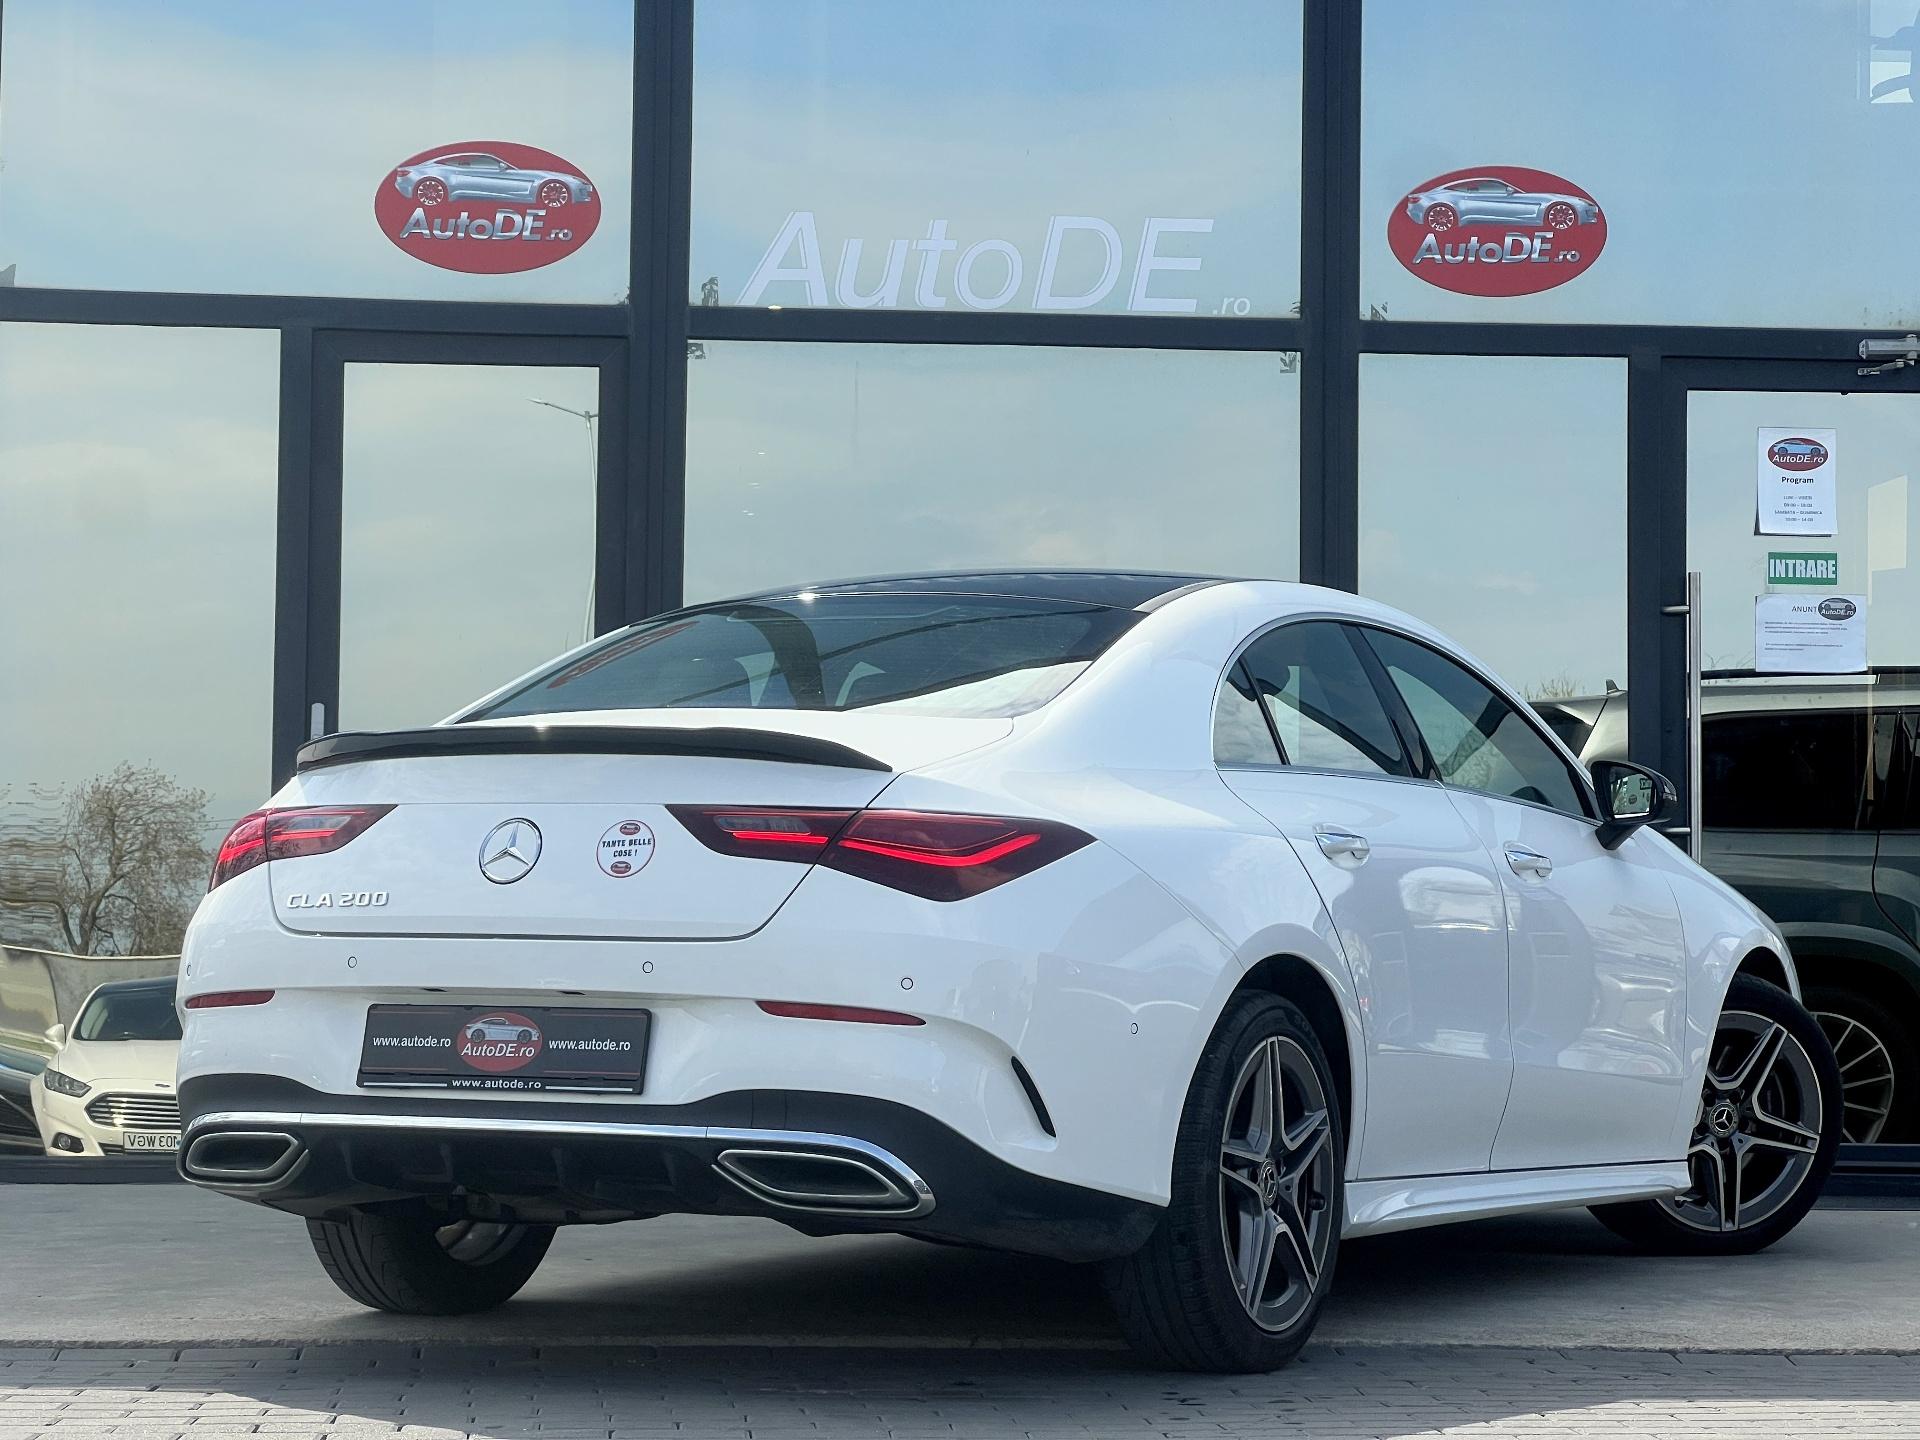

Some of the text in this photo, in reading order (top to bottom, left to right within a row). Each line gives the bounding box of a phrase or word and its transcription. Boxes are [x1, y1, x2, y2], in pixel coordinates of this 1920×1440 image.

[1772, 454, 1824, 464] AutoDE.ro
[1781, 476, 1814, 484] Program
[1769, 559, 1836, 578] INTRARE
[602, 838, 652, 848] TANTE BELLE
[613, 849, 632, 857] COSE
[286, 891, 389, 908] CLA 200
[372, 1035, 451, 1048] www.autode.ro
[549, 1039, 631, 1051] www.autode.ro
[461, 1042, 535, 1058] AutoDE.ro
[452, 1078, 541, 1090] www.autode.ro
